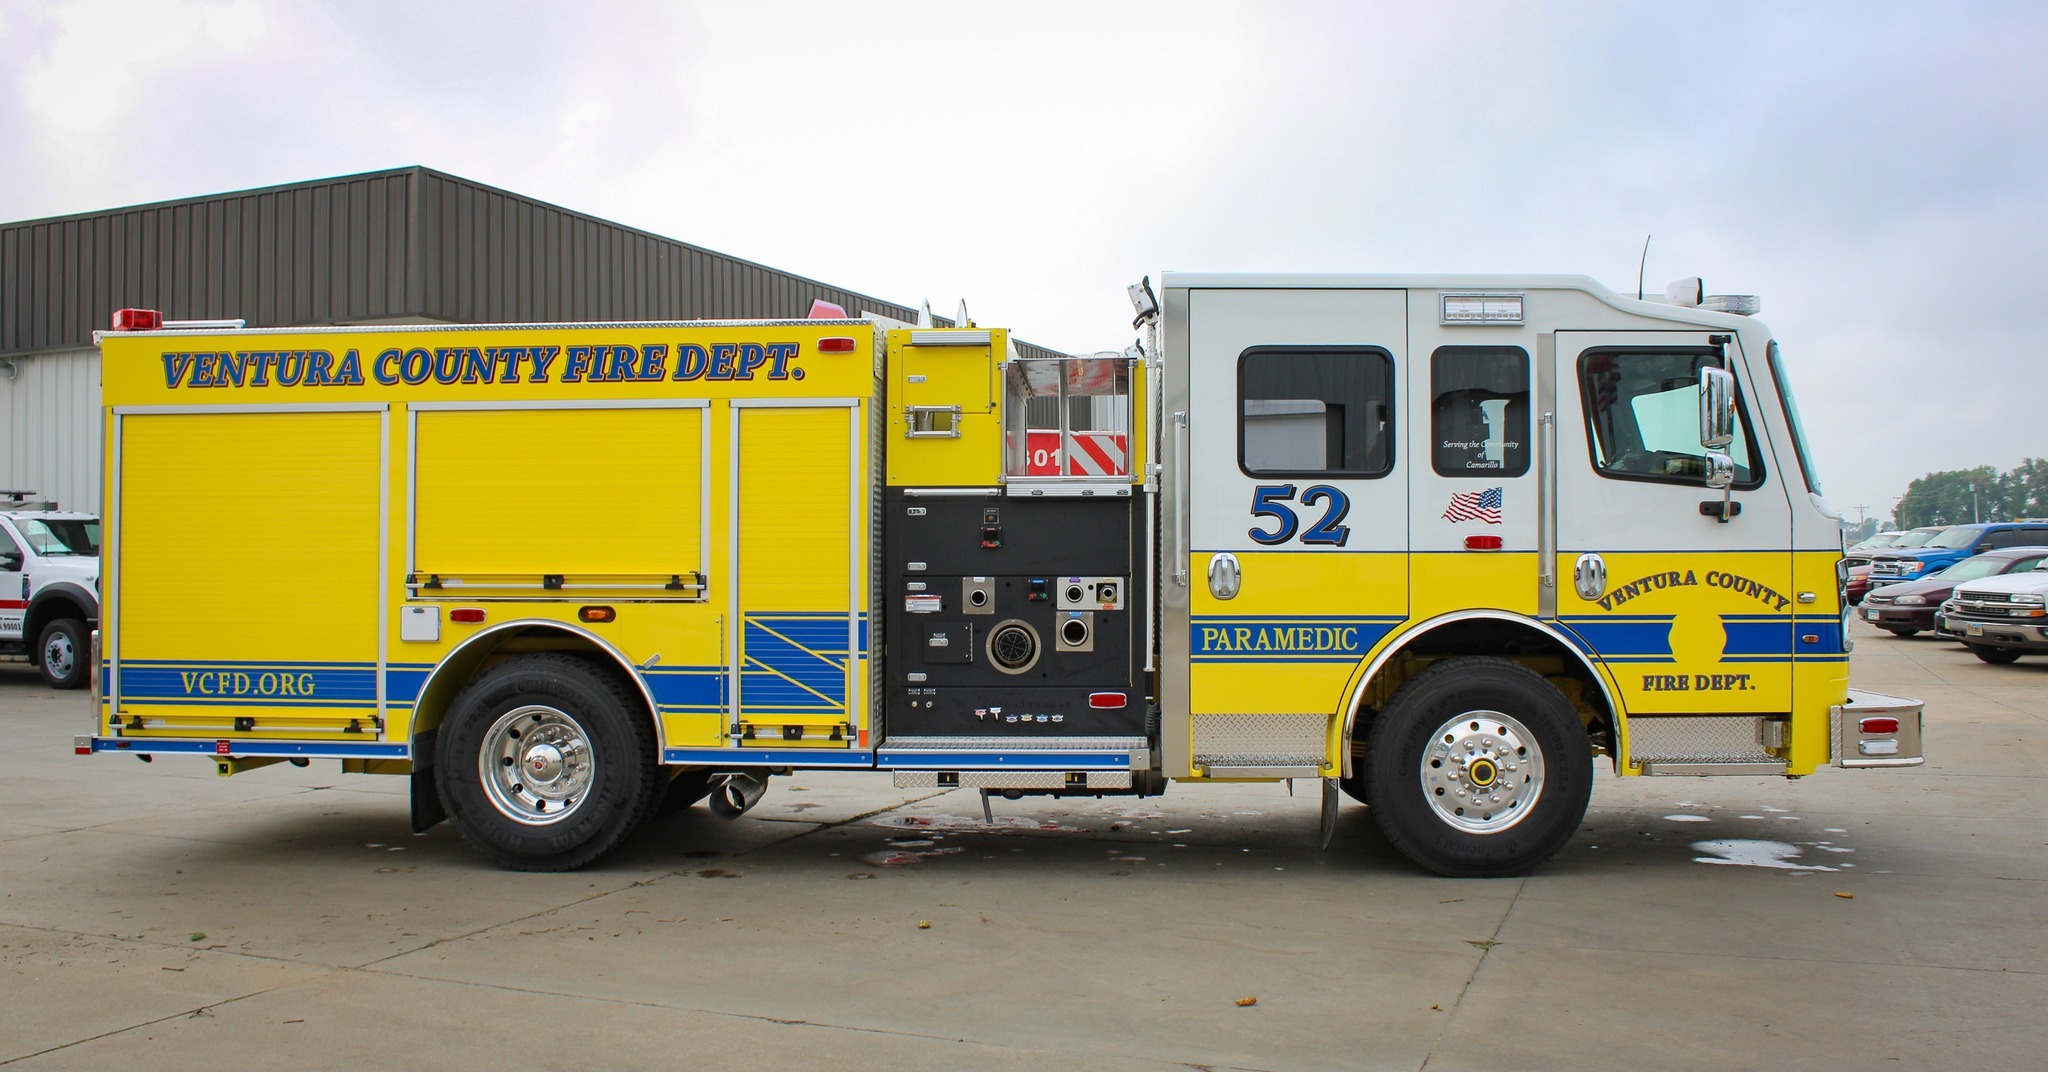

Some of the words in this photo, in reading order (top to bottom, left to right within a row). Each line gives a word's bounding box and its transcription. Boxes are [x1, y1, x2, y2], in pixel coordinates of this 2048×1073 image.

[161, 349, 364, 388] VENTURA
[372, 345, 560, 387] COUNTY
[561, 344, 668, 383] FIRE
[672, 342, 805, 381] DEPT.
[1443, 440, 1468, 450] Serving
[1469, 440, 1480, 448] the
[1477, 451, 1485, 459] of
[1248, 484, 1350, 547] 52
[1596, 570, 1698, 612] VENTURA
[1705, 570, 1791, 612] COUNTY
[1202, 627, 1358, 651] PARAMEDIC
[180, 671, 315, 695] VCFD.ORG
[1642, 675, 1690, 691] FIRE
[1694, 674, 1755, 690] DEPT.
